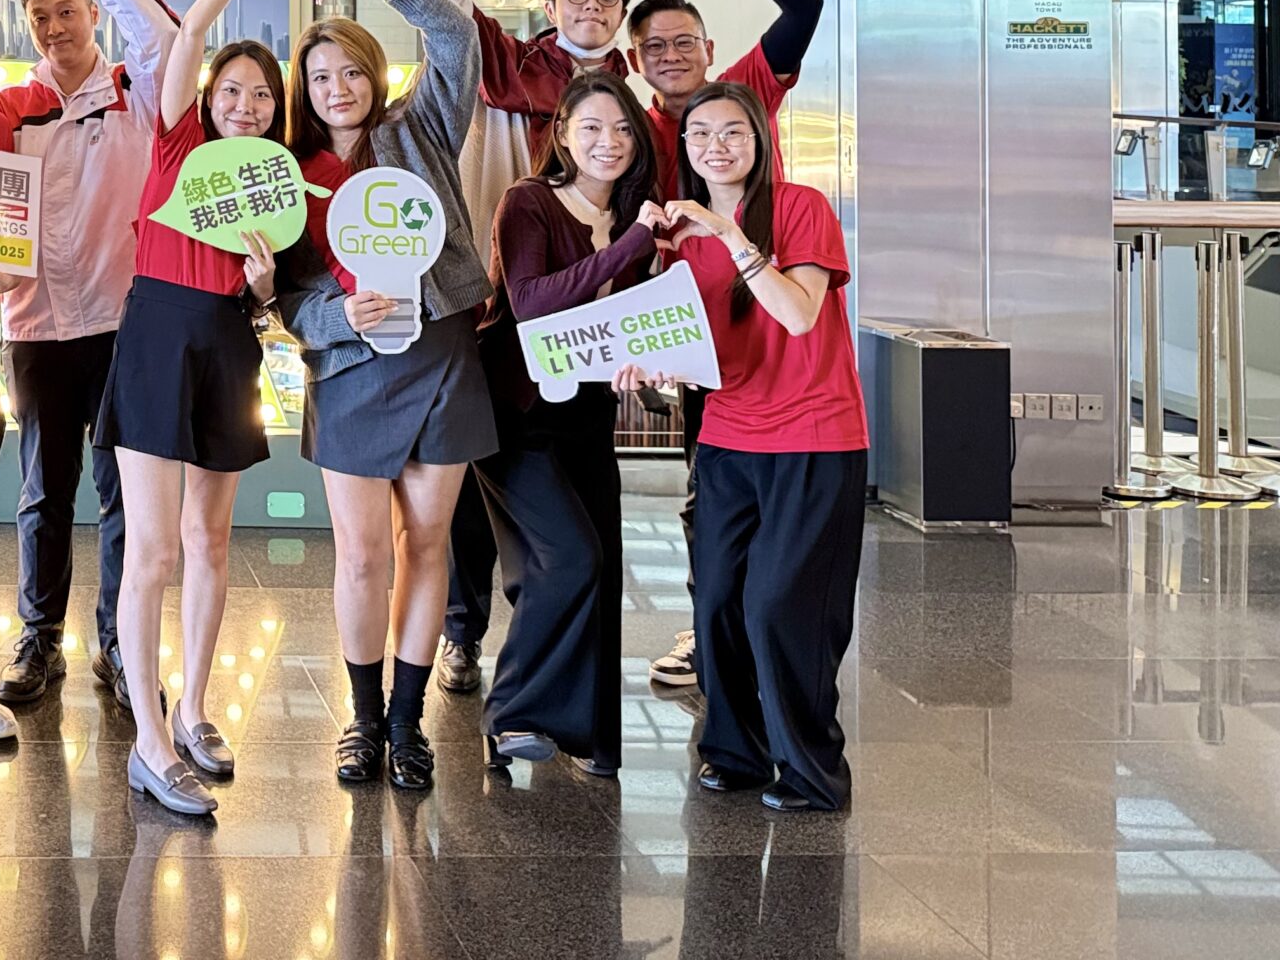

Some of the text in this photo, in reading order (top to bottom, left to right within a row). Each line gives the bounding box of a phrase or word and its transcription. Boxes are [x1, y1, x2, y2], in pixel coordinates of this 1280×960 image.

[1010, 24, 1086, 33] HACKETT
[338, 225, 429, 257] Green
[540, 302, 696, 353] THINK GREEN
[549, 324, 703, 374] LIVE GREEN
